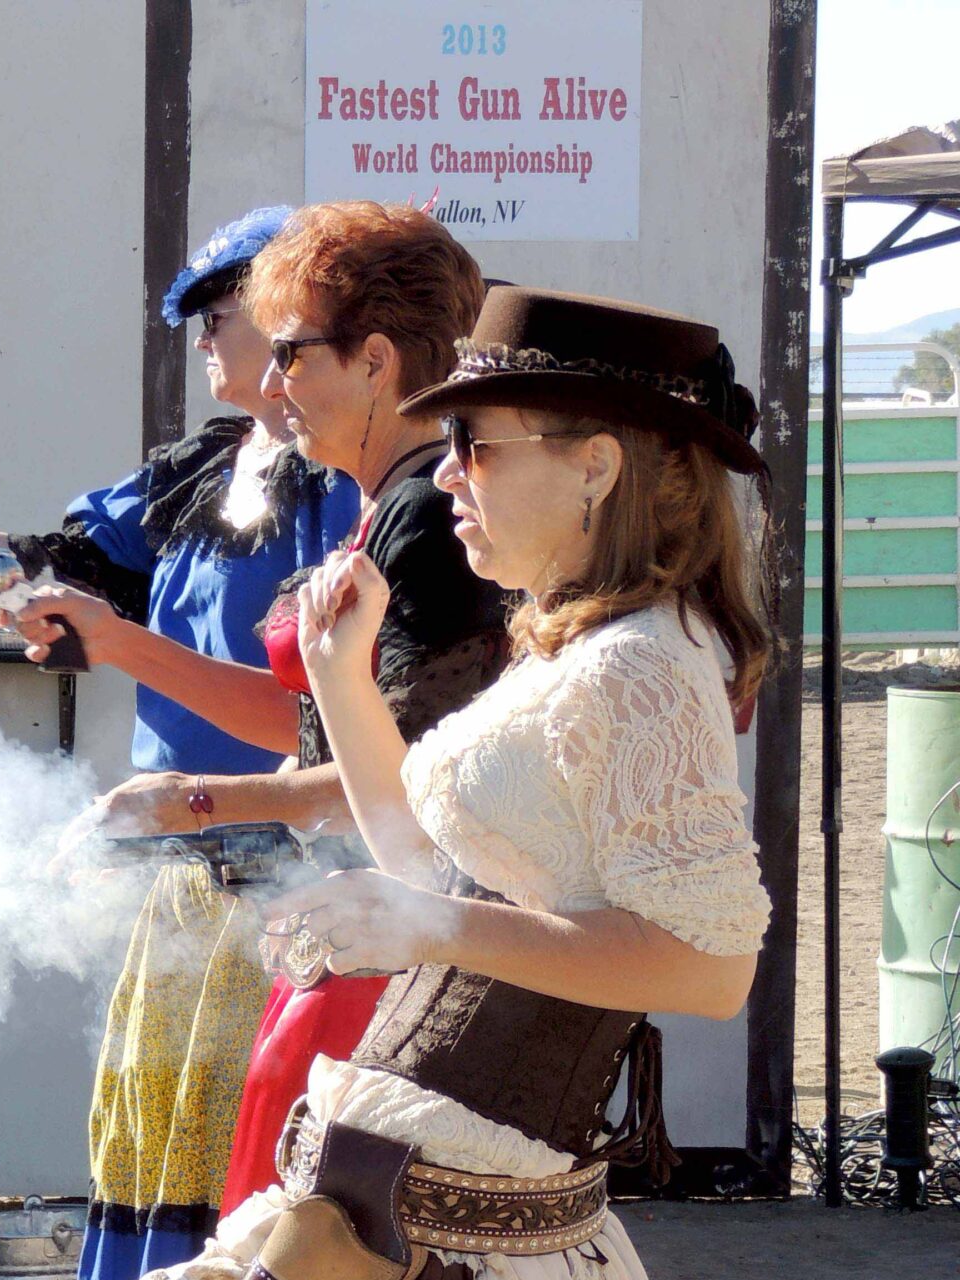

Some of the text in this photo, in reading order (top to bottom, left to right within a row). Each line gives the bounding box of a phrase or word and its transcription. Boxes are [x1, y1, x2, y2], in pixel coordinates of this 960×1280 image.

[442, 24, 507, 56] 2013
[318, 76, 628, 122] Fastest Gun Alive
[352, 143, 593, 184] World Championship
[492, 200, 526, 224] NV
